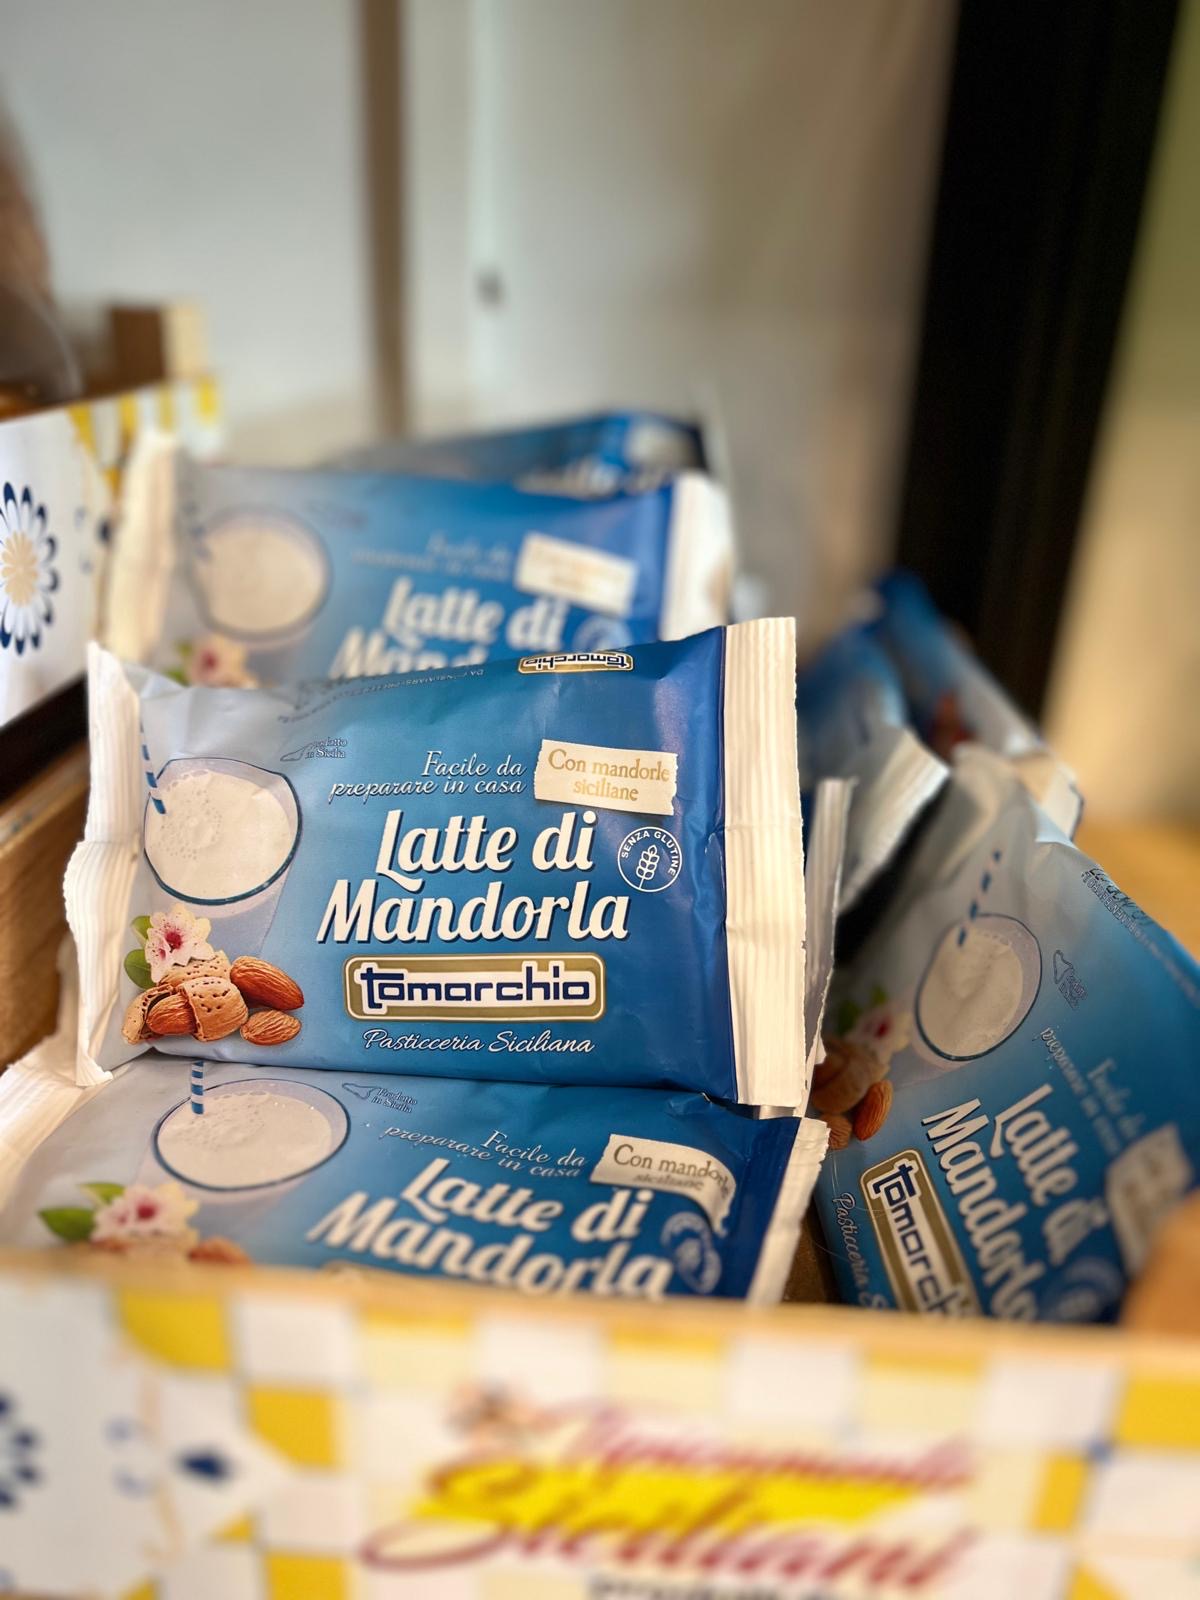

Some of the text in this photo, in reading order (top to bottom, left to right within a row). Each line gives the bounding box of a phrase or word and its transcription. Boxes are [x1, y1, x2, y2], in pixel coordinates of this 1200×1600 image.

[383, 576, 505, 651] Latte
[420, 750, 528, 777] Facile da
[547, 748, 670, 783] Con mandorle
[328, 775, 526, 804] preparare in casa
[573, 776, 640, 803] siciliane
[375, 808, 600, 894] Latte di
[621, 830, 679, 876] SENZA GLUTINE
[316, 879, 632, 944] Mandorla
[358, 962, 592, 1011] tomarchio
[362, 1028, 596, 1055] Pasticceria Siciliana
[380, 1126, 492, 1163] preparare
[530, 1160, 582, 1178] casa
[480, 1129, 588, 1167] Facile da
[613, 1143, 653, 1170] Con
[989, 1083, 1079, 1206] Latte
[401, 1157, 654, 1243] Latte di
[306, 1192, 676, 1299] Mandorla
